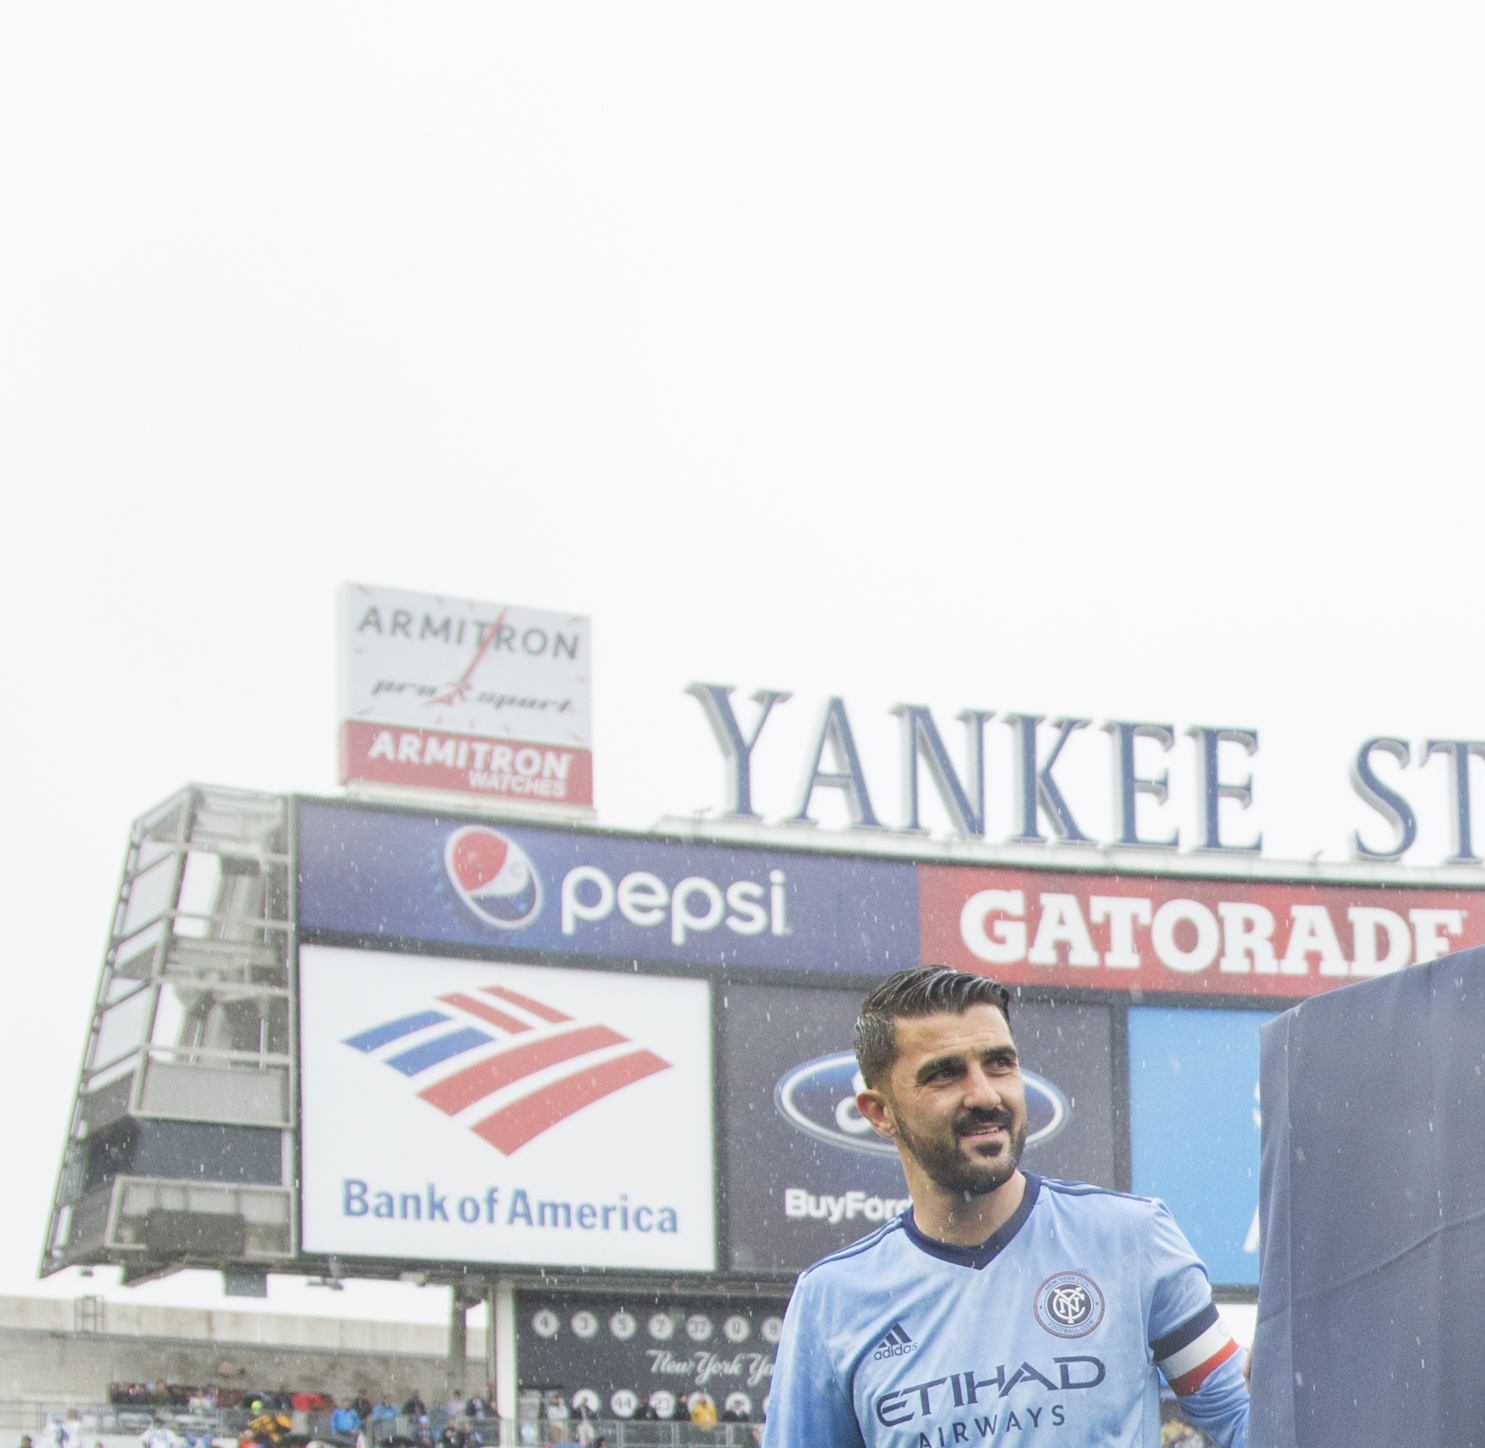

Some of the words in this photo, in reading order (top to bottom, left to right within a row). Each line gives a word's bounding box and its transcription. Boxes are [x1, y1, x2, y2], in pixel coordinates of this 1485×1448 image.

[356, 605, 579, 660] ARMITRON
[367, 730, 575, 780] ARMITRON
[683, 681, 1263, 856] YANKEE
[468, 769, 568, 799] WATCHES
[560, 869, 789, 946] pepsi
[959, 888, 1464, 980] GATORADE
[342, 1178, 449, 1222] Bank
[458, 1185, 499, 1224] of
[506, 1188, 679, 1235] America
[646, 1349, 696, 1374] New
[694, 1351, 747, 1385] York
[873, 1339, 919, 1361] adidas
[876, 1354, 1106, 1428] ETIHAD
